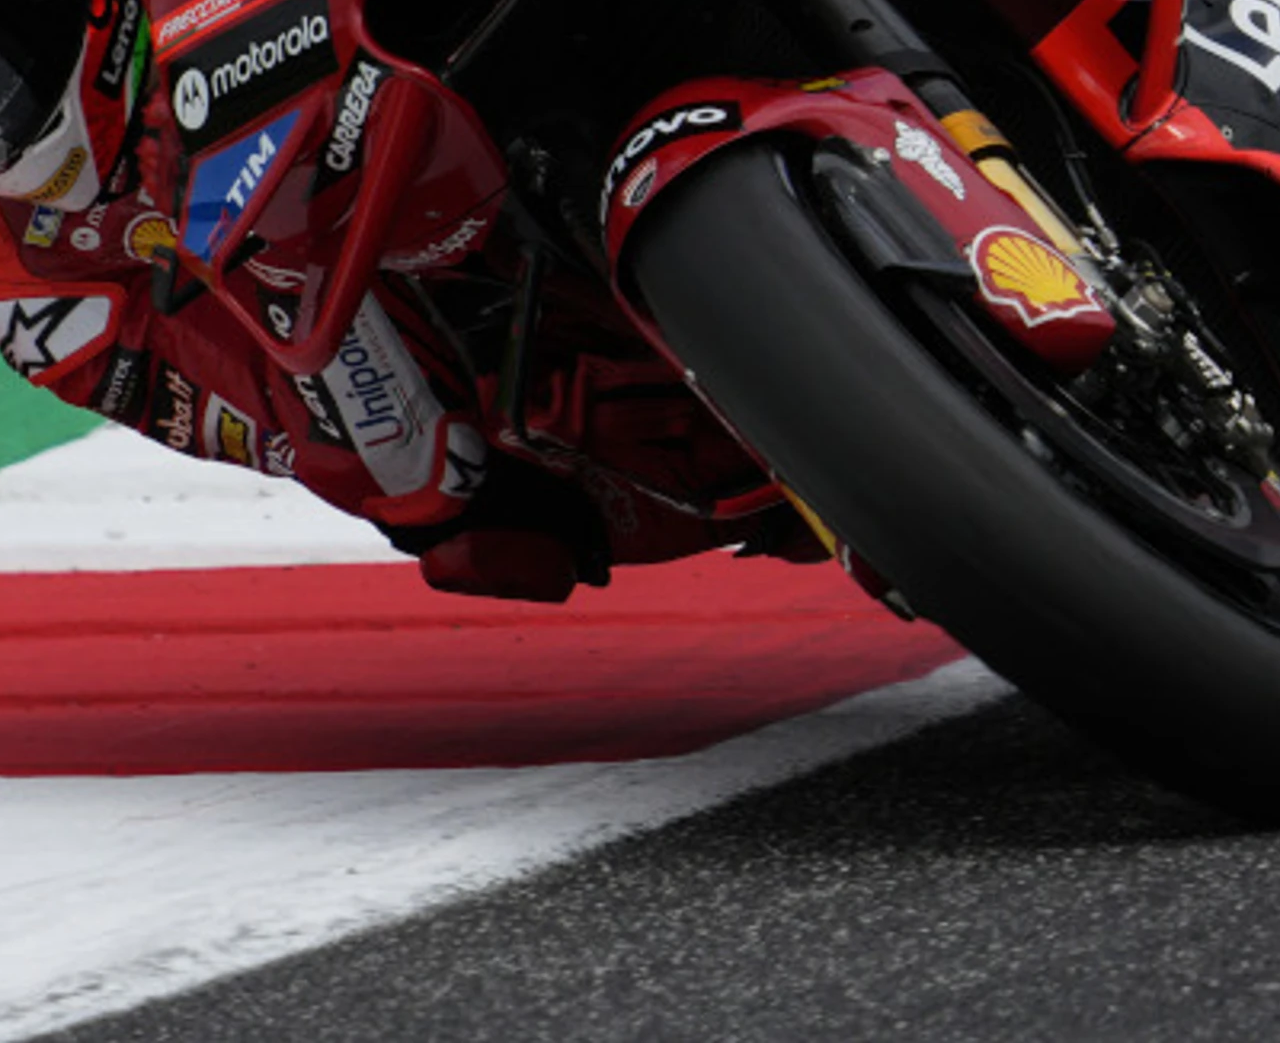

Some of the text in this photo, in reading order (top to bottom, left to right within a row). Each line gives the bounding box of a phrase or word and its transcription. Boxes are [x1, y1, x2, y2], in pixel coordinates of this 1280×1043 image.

[210, 14, 329, 99] motorola
[325, 60, 382, 173] CARRERA
[224, 131, 278, 209] TIM
